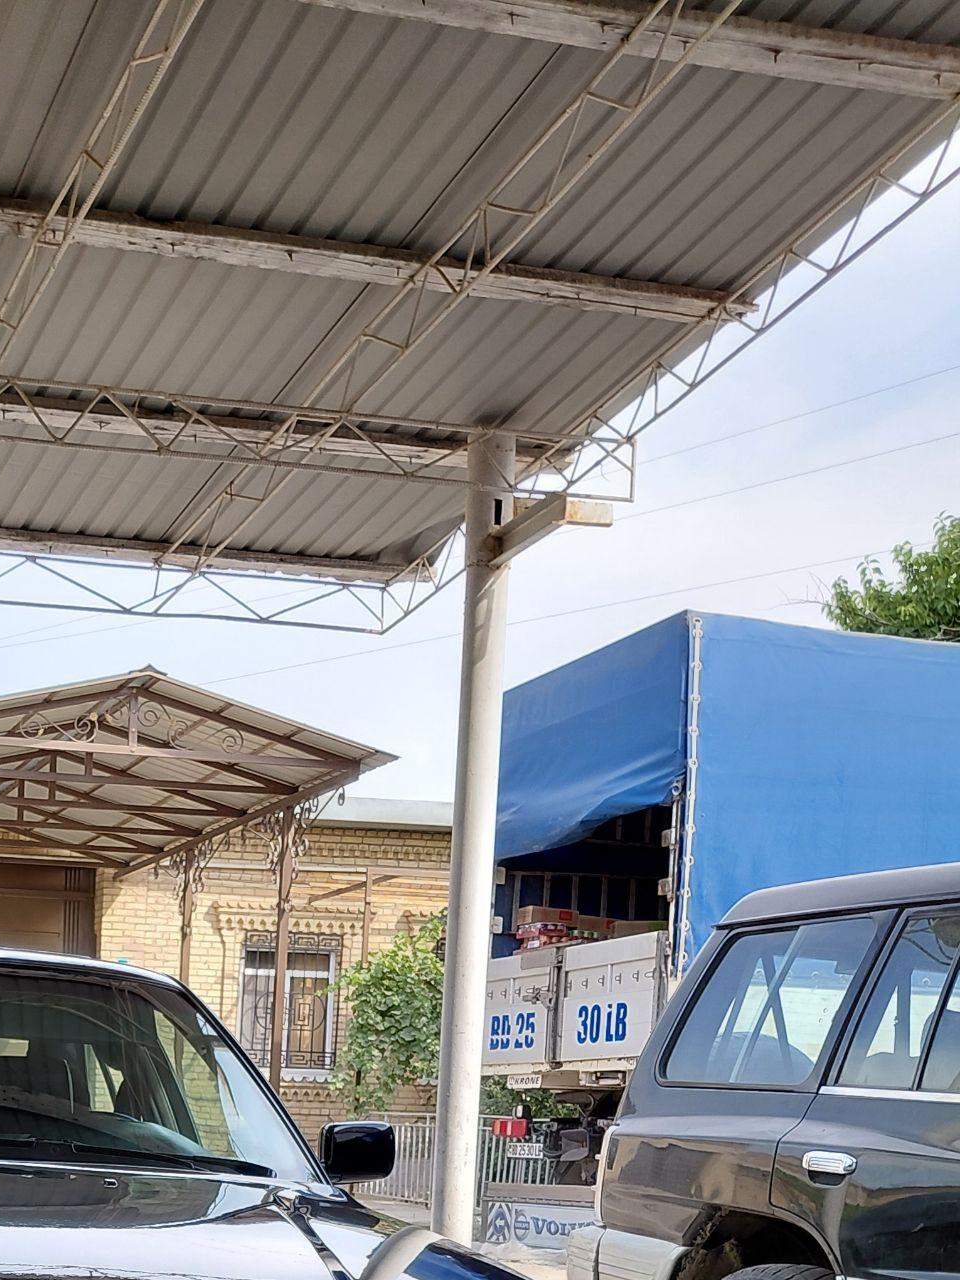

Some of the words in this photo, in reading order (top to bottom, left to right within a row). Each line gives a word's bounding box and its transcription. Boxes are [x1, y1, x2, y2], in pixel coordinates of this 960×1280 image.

[513, 1011, 537, 1050] 25
[576, 1003, 602, 1045] 30
[514, 1076, 541, 1086] KRONE
[530, 1216, 594, 1237] VOL
